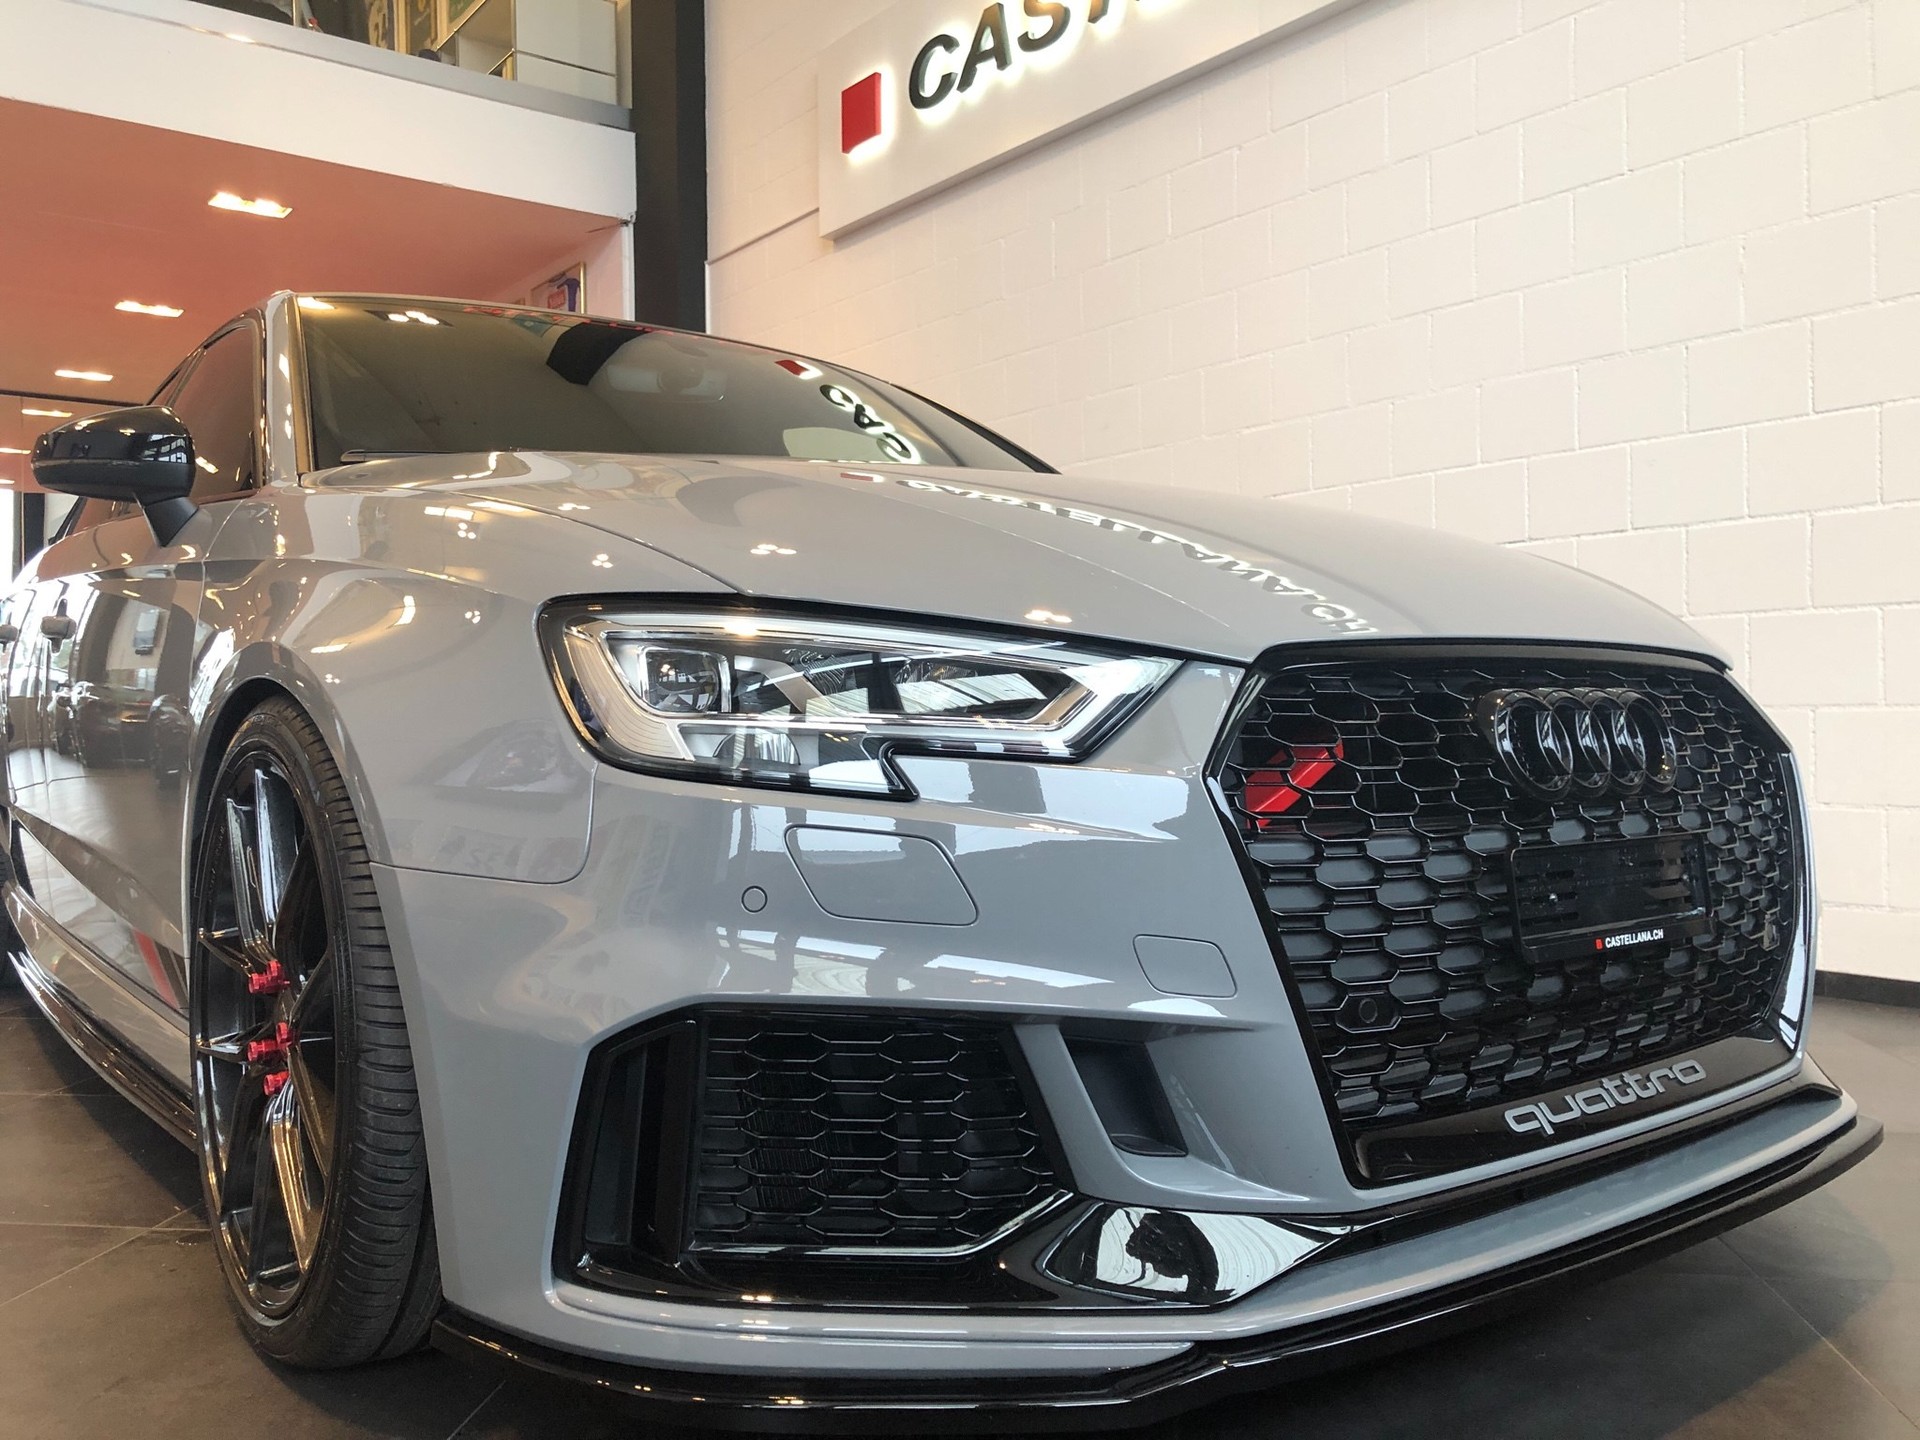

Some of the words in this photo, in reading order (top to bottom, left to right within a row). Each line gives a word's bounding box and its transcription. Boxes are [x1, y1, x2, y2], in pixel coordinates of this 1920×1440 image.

[908, 0, 1109, 110] CAS
[1605, 928, 1664, 949] CASTELLANA.CH
[1504, 1059, 1707, 1135] quattro
